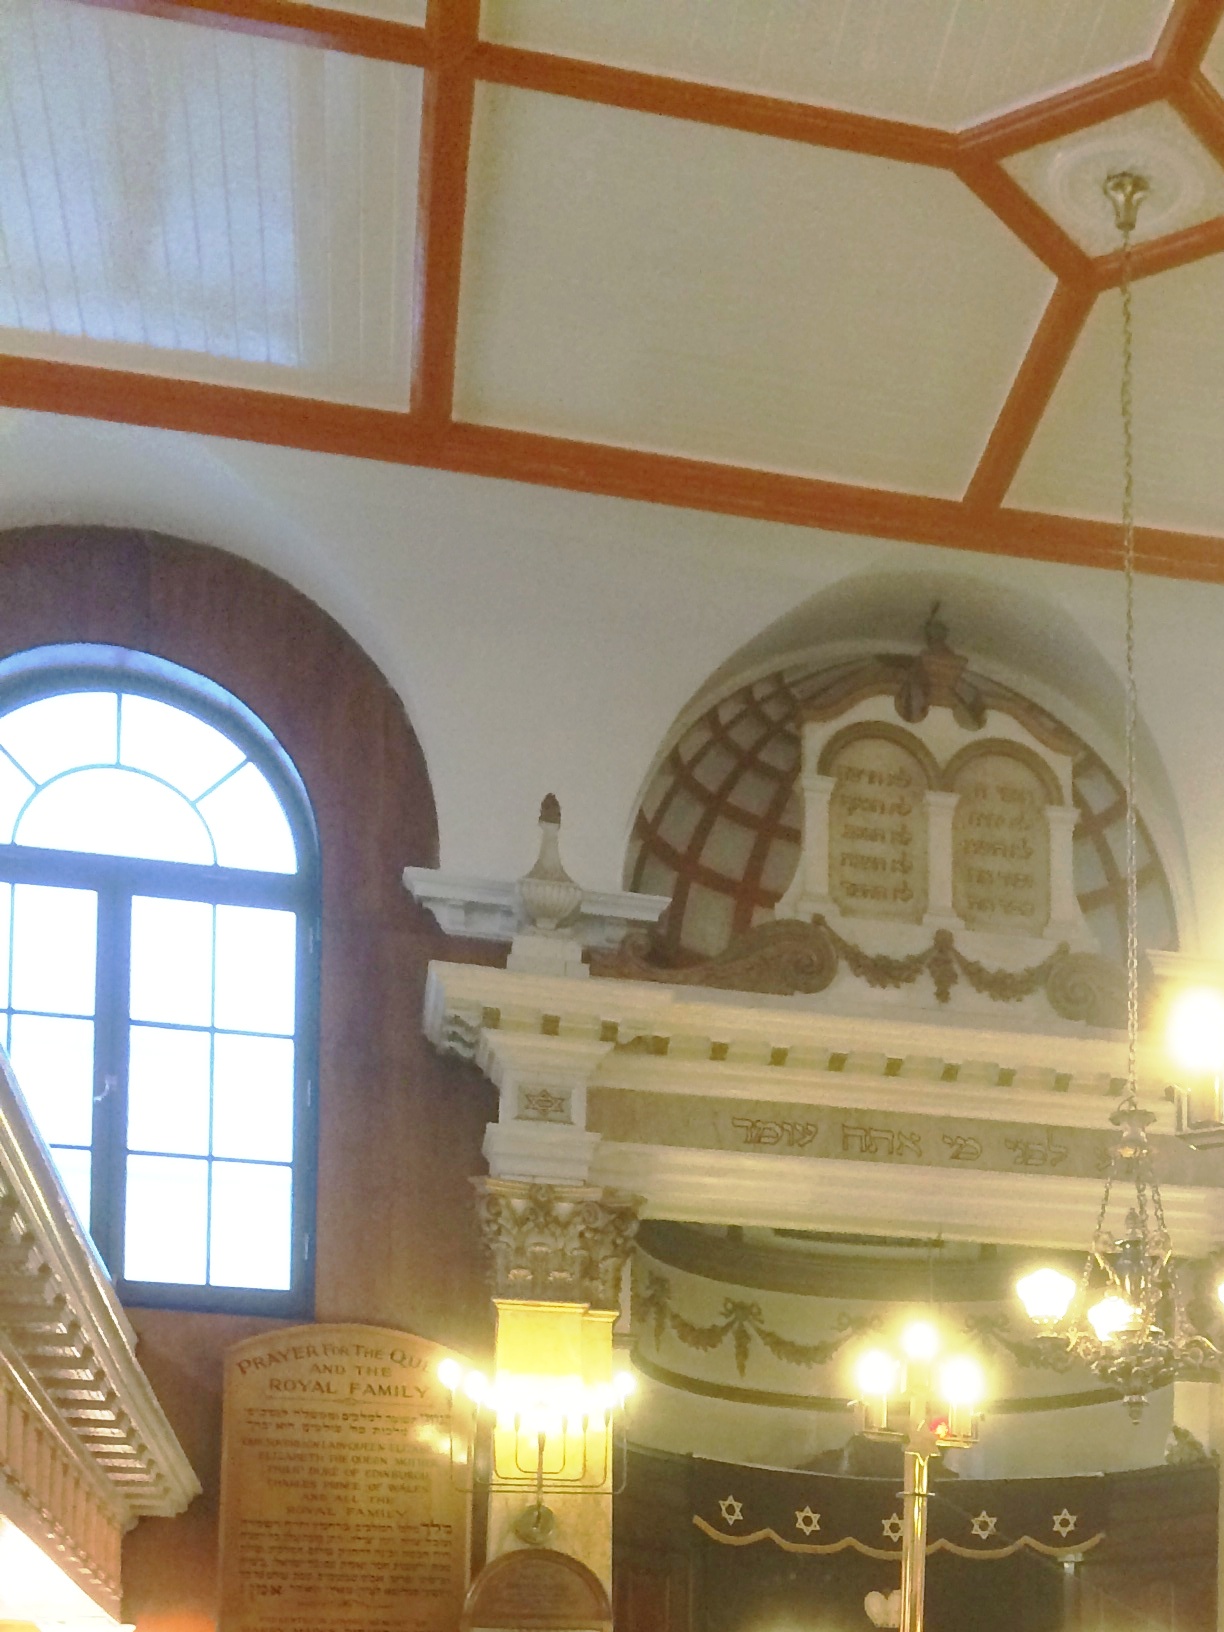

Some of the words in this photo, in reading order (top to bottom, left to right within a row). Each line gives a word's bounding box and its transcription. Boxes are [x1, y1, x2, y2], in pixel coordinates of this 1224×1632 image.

[731, 1115, 819, 1148] עומד
[842, 1122, 923, 1158] אתה
[942, 1132, 983, 1162] מי
[1005, 1126, 1068, 1168] לפני
[236, 1345, 317, 1374] PRAYER
[310, 1362, 346, 1376] AND
[356, 1365, 392, 1378] THE
[268, 1378, 337, 1395] ROYAL
[349, 1382, 428, 1399] FAMILY
